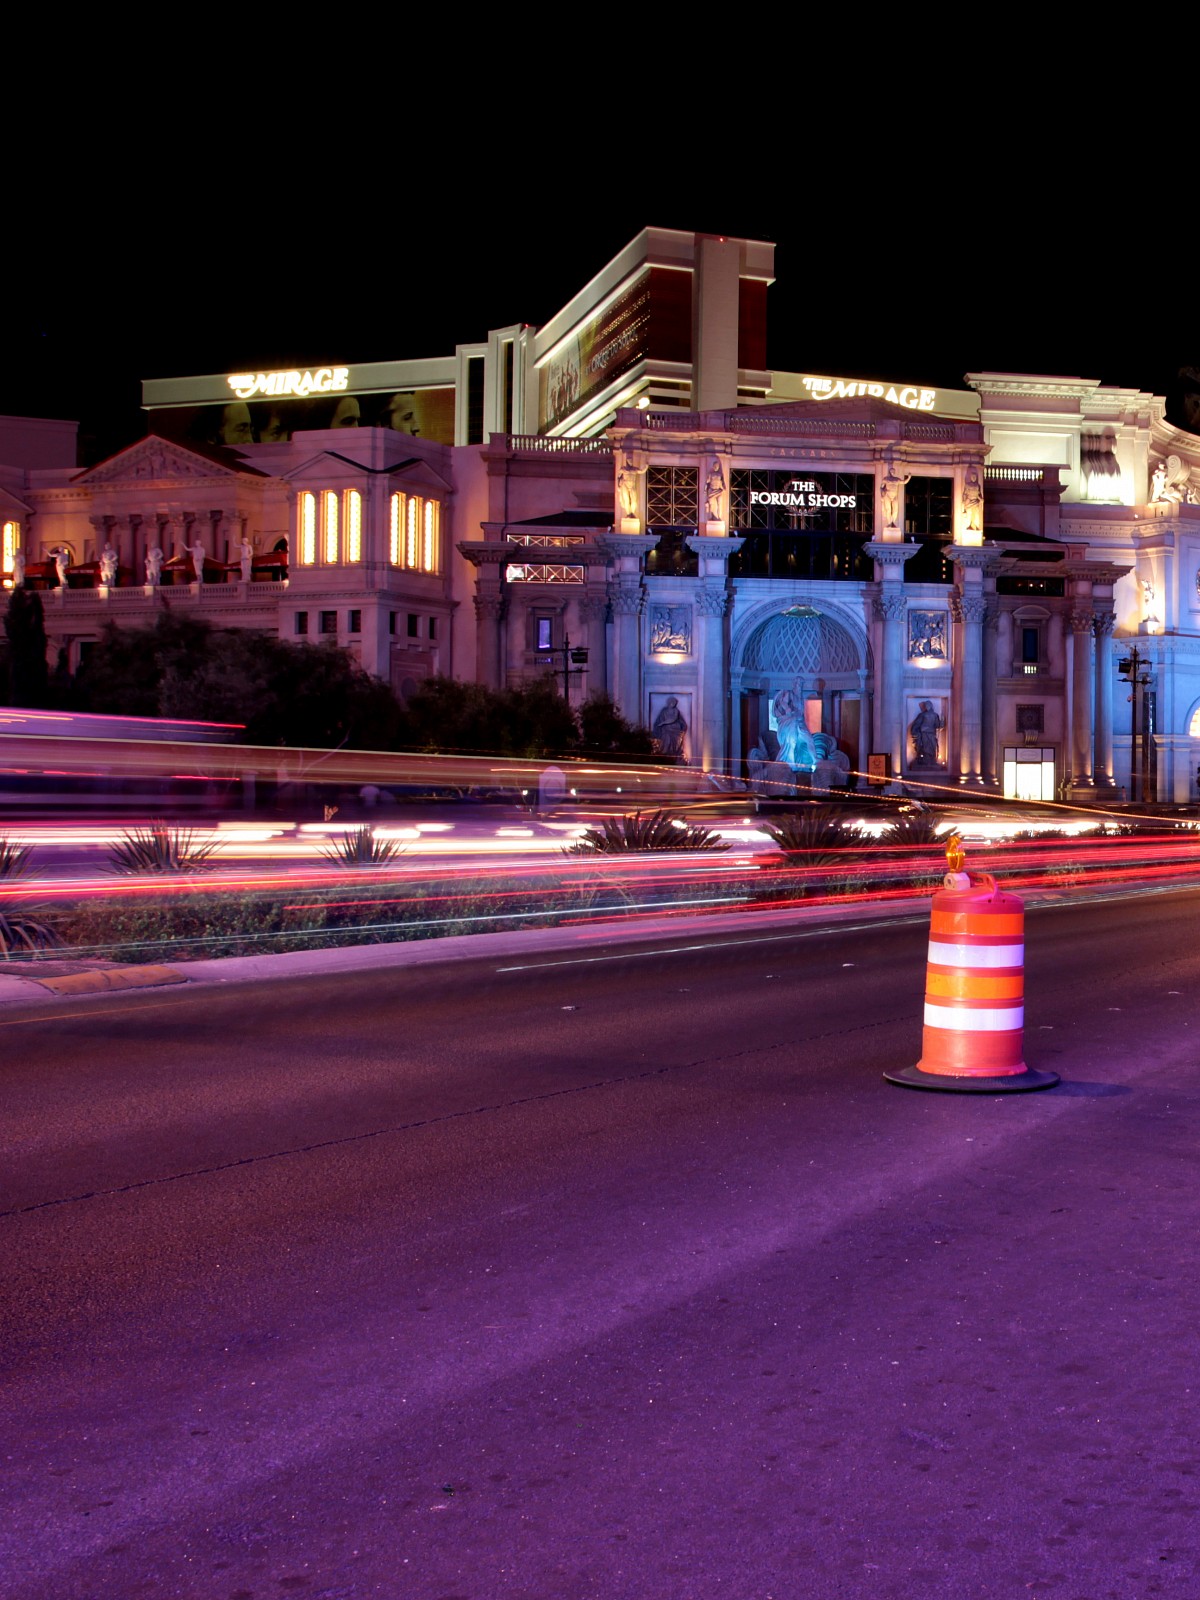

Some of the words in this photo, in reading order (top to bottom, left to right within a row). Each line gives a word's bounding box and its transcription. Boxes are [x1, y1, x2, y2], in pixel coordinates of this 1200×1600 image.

[235, 367, 349, 398] MIRAGE
[802, 377, 832, 392] THE
[811, 380, 936, 411] MIRAGE
[792, 481, 815, 492] THE
[750, 491, 805, 506] FORUM
[808, 493, 857, 508] SHOPS
